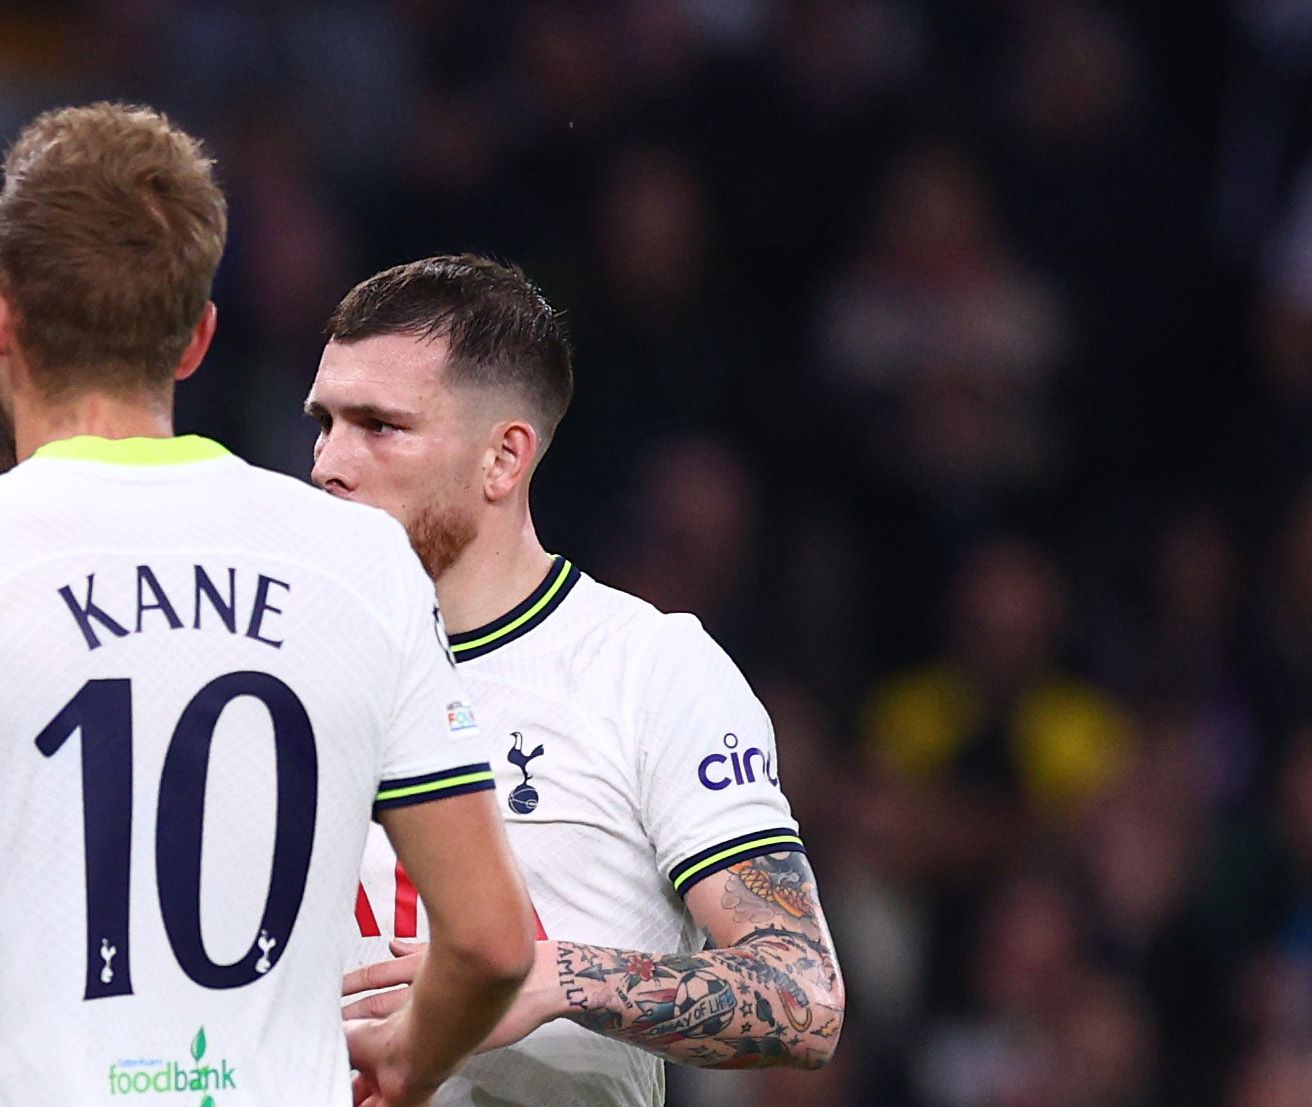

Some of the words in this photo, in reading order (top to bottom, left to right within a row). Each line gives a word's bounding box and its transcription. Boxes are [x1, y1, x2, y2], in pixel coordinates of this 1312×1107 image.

[57, 564, 291, 651] KANE
[34, 670, 319, 1001] 10
[109, 1059, 237, 1095] foodbank
